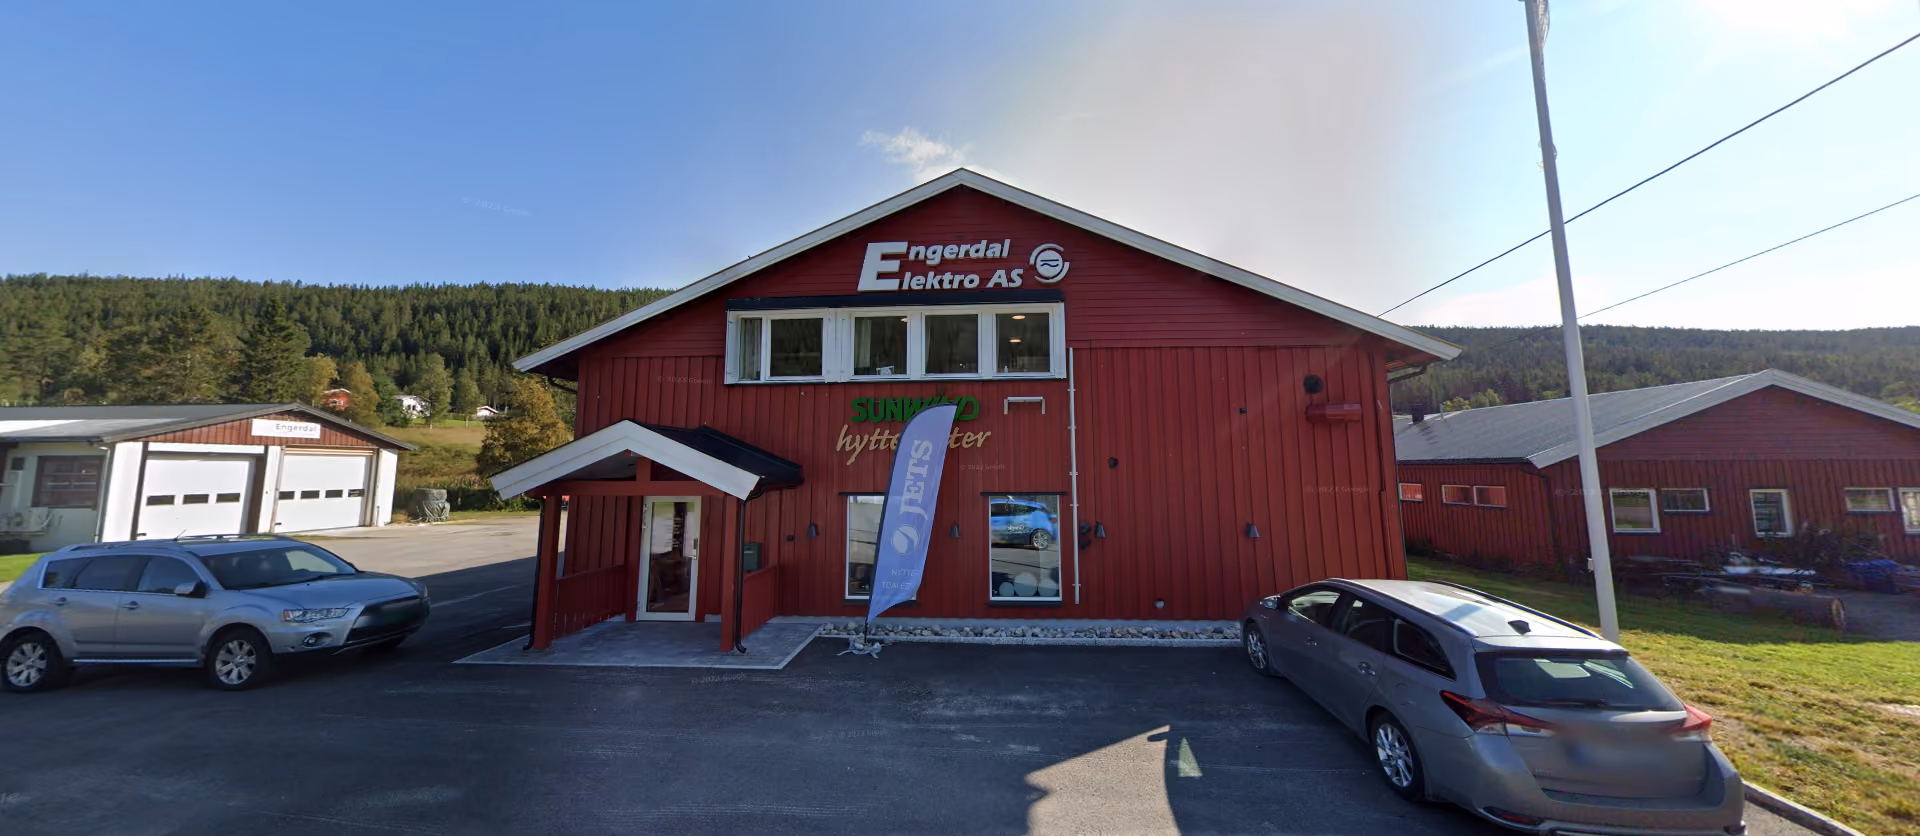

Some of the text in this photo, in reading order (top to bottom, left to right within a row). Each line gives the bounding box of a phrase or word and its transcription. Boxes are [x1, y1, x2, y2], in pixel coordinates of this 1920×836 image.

[857, 239, 1011, 291] Engerdal
[986, 269, 1024, 288] AS
[275, 423, 317, 432] Engerdal
[900, 439, 933, 520] JETS
